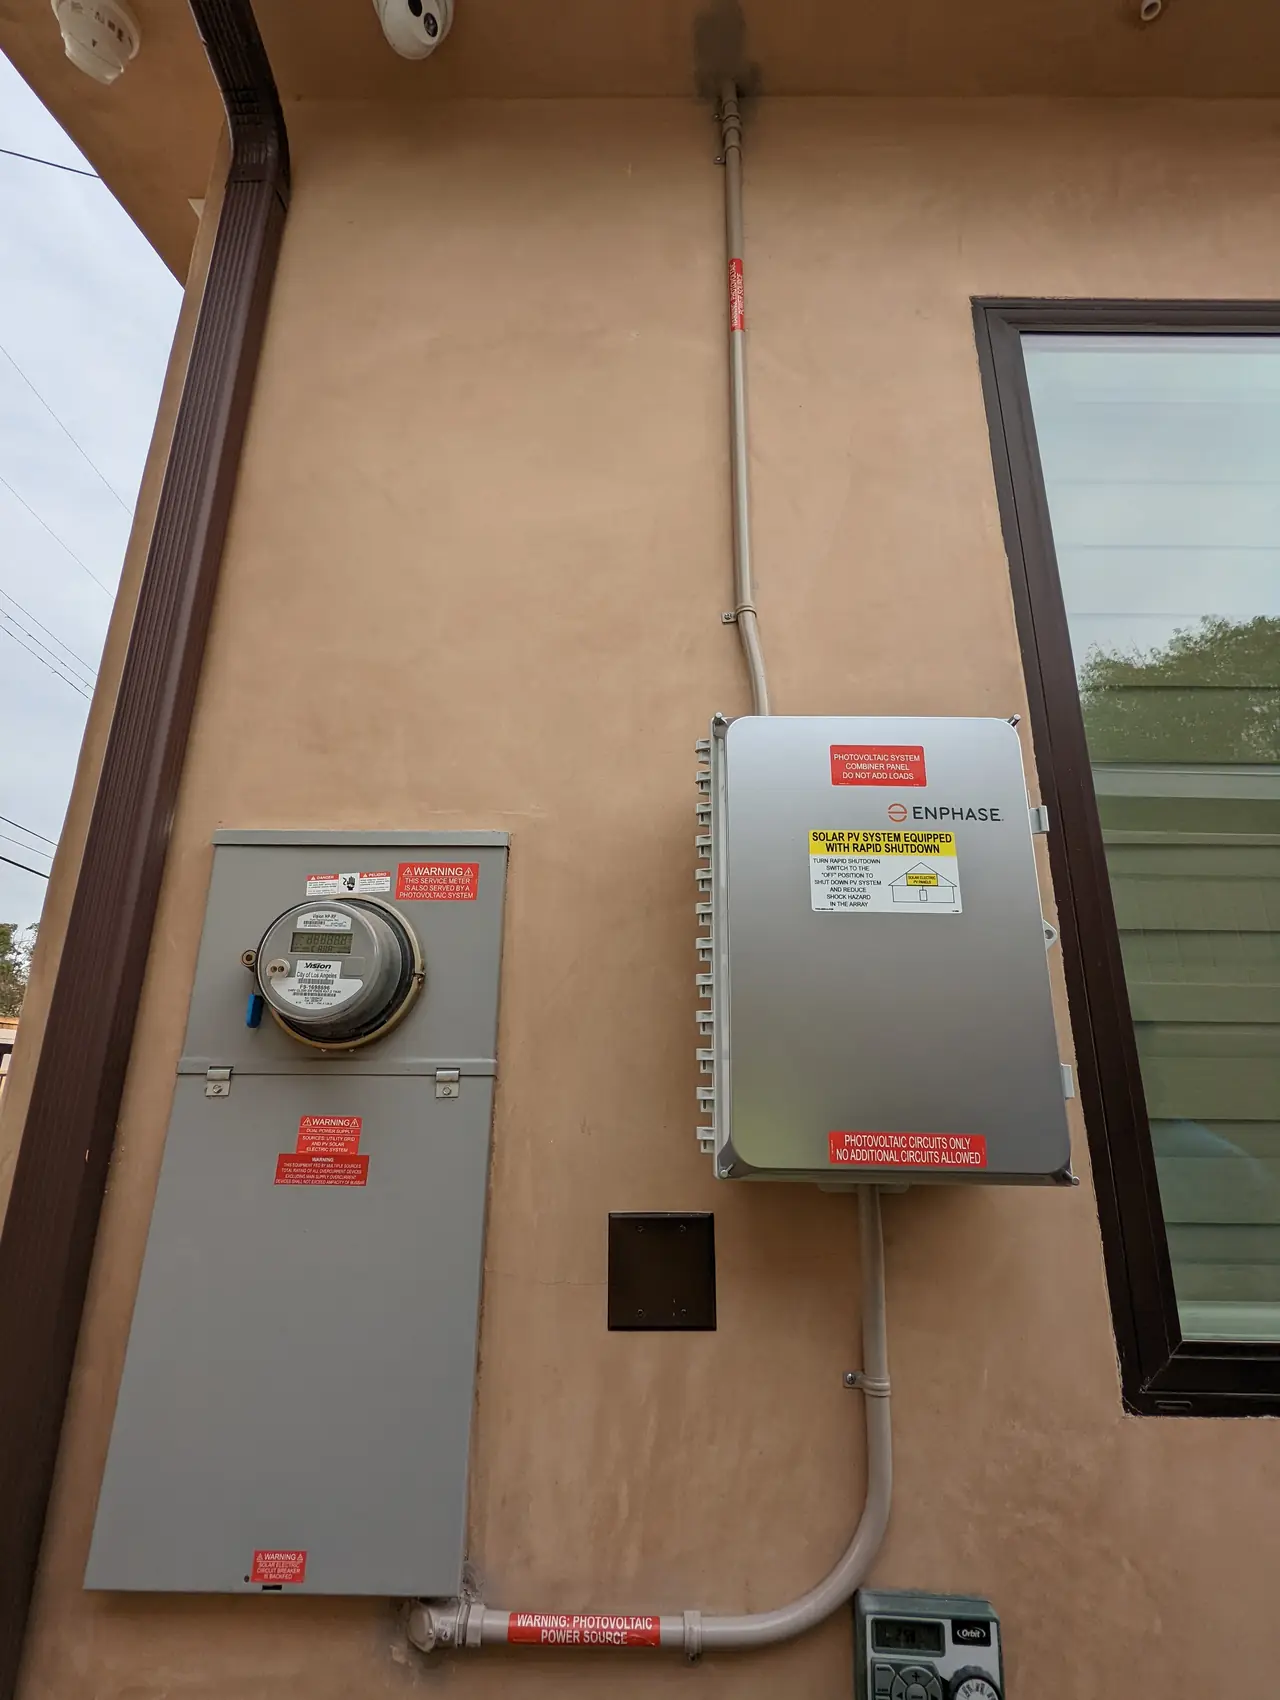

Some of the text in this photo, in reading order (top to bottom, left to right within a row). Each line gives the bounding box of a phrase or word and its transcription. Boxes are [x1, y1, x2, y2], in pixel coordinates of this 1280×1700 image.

[833, 753, 889, 761] PHOTOVOLTAIC
[812, 832, 952, 843] SOLAR PV SYSTEM EQUIPPED
[826, 843, 940, 853] WITH RAPID SHUTDOWN
[413, 867, 463, 876] WARNING
[304, 962, 332, 970] Vision
[312, 1118, 350, 1127] WARNING
[844, 1134, 907, 1148] PHOTOVOLTAIC
[908, 1136, 947, 1149] CIRCUITS
[949, 1137, 971, 1150] ONLY
[836, 1148, 981, 1164] NO ADDITIONAL CIRCUITS ALLOWED
[264, 1553, 296, 1561] WARNING
[517, 1614, 653, 1630] WARNING: PHOTOVOLTAIC
[541, 1629, 628, 1645] POWER SOURCE
[961, 1630, 981, 1638] Orbit
